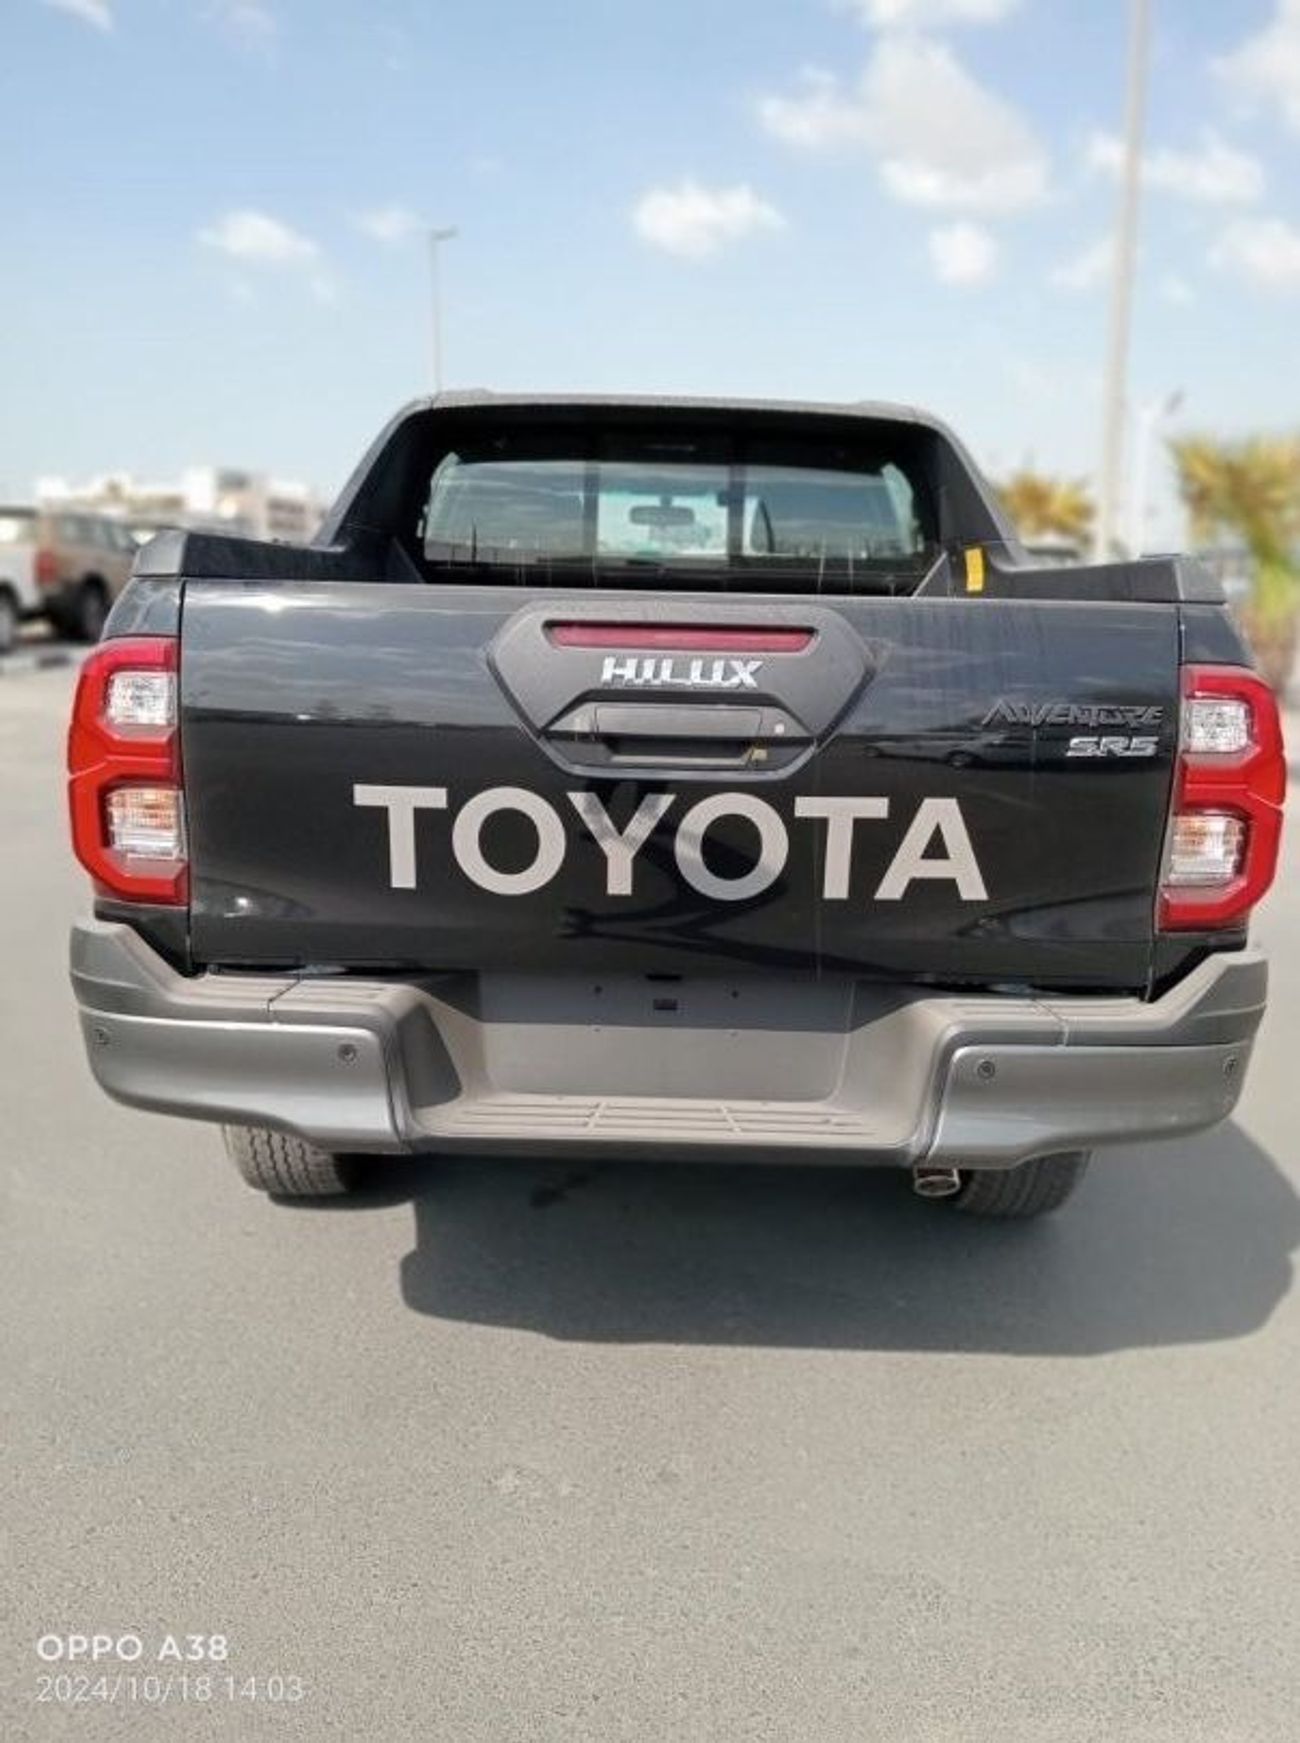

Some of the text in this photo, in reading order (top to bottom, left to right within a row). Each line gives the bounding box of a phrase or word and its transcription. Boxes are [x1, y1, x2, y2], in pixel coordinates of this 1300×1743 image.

[601, 656, 764, 688] HILUX
[1066, 736, 1160, 757] SR5
[353, 784, 989, 901] TOYOTA
